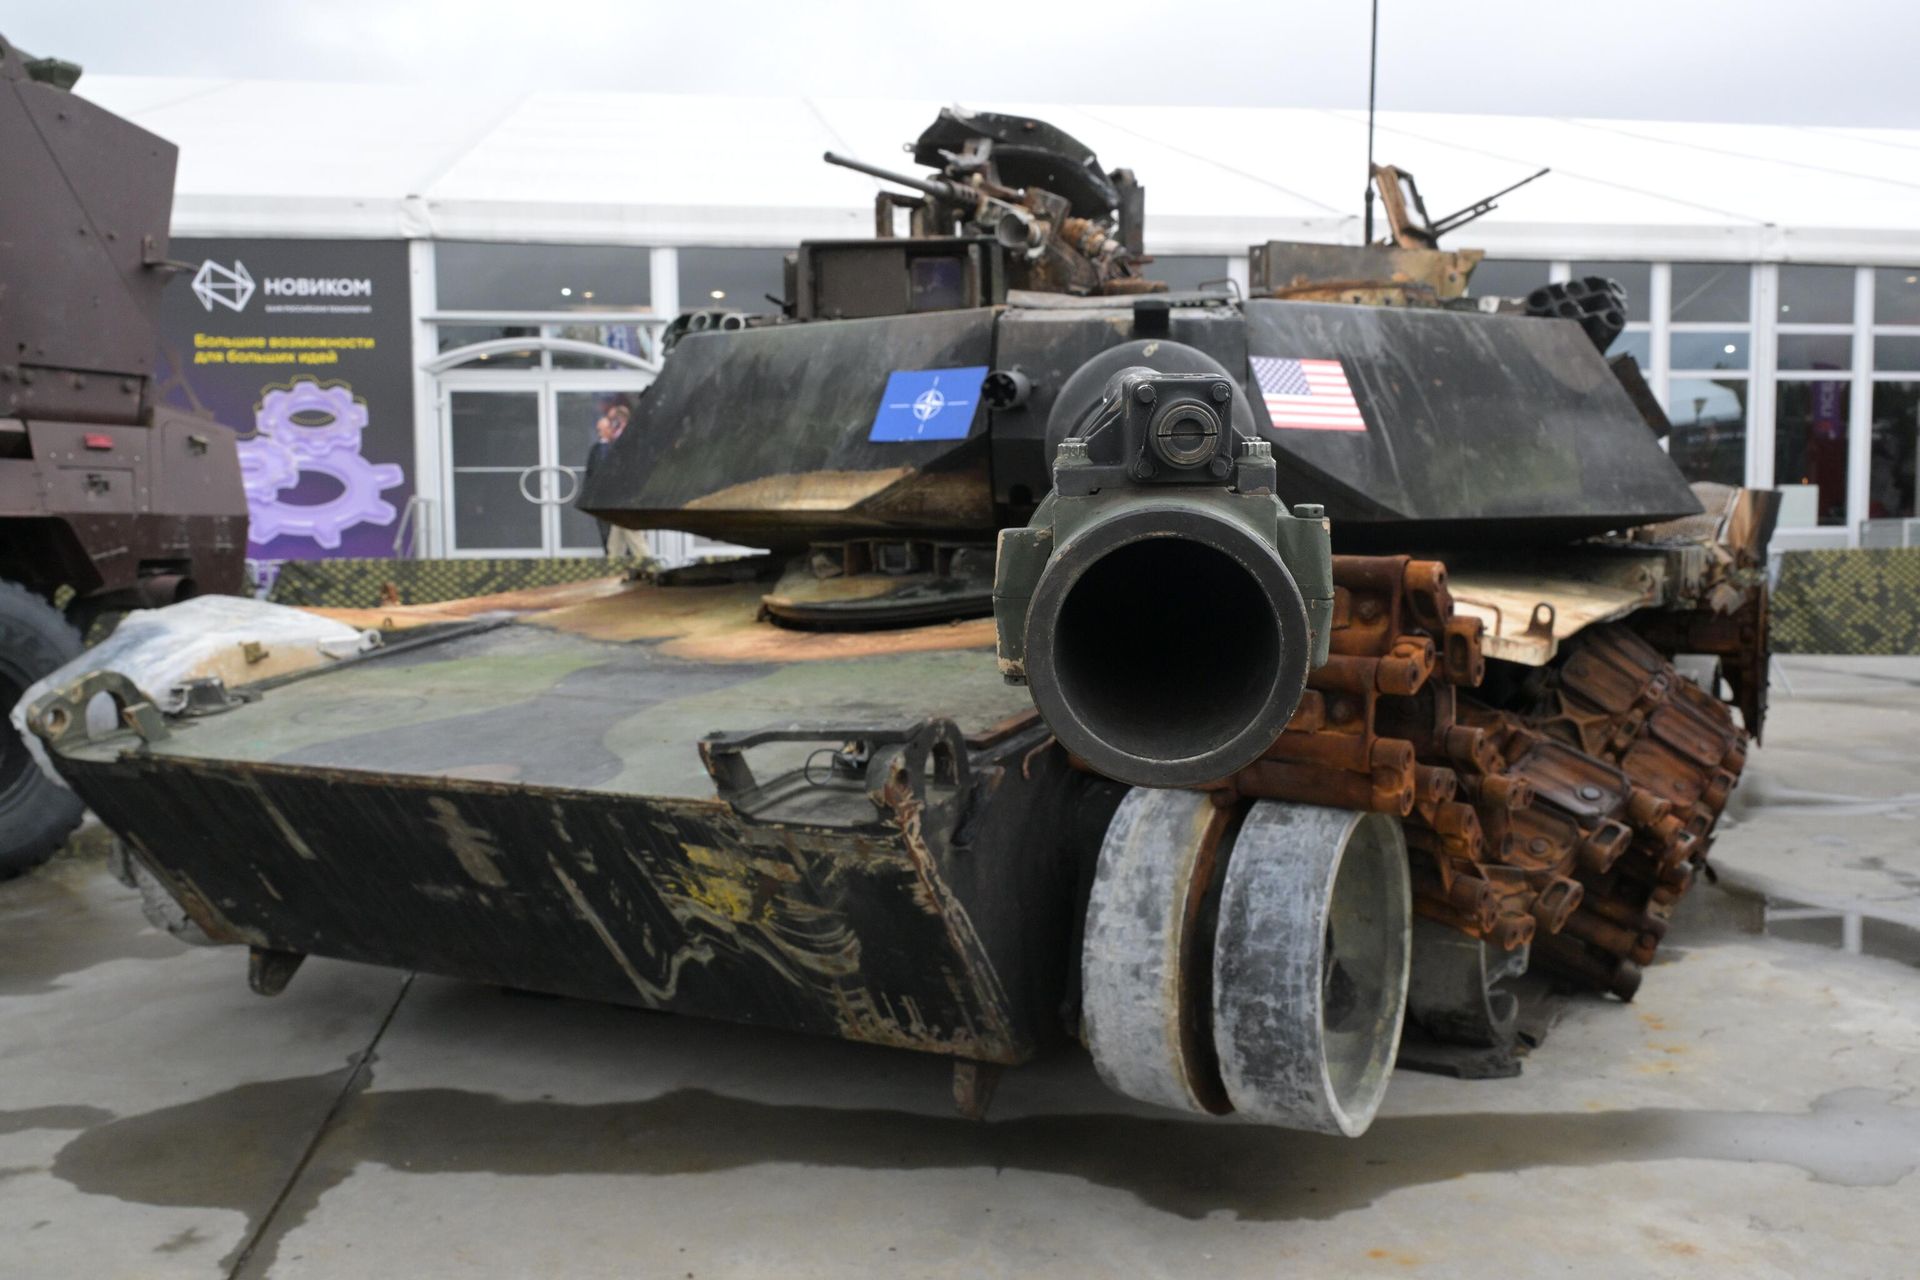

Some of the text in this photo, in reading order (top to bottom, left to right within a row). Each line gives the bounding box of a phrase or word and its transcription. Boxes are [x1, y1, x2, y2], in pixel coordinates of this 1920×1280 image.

[264, 277, 372, 296] НОВИКОМ
[193, 332, 375, 349] Большие возможности
[193, 349, 338, 364] для больших идей
